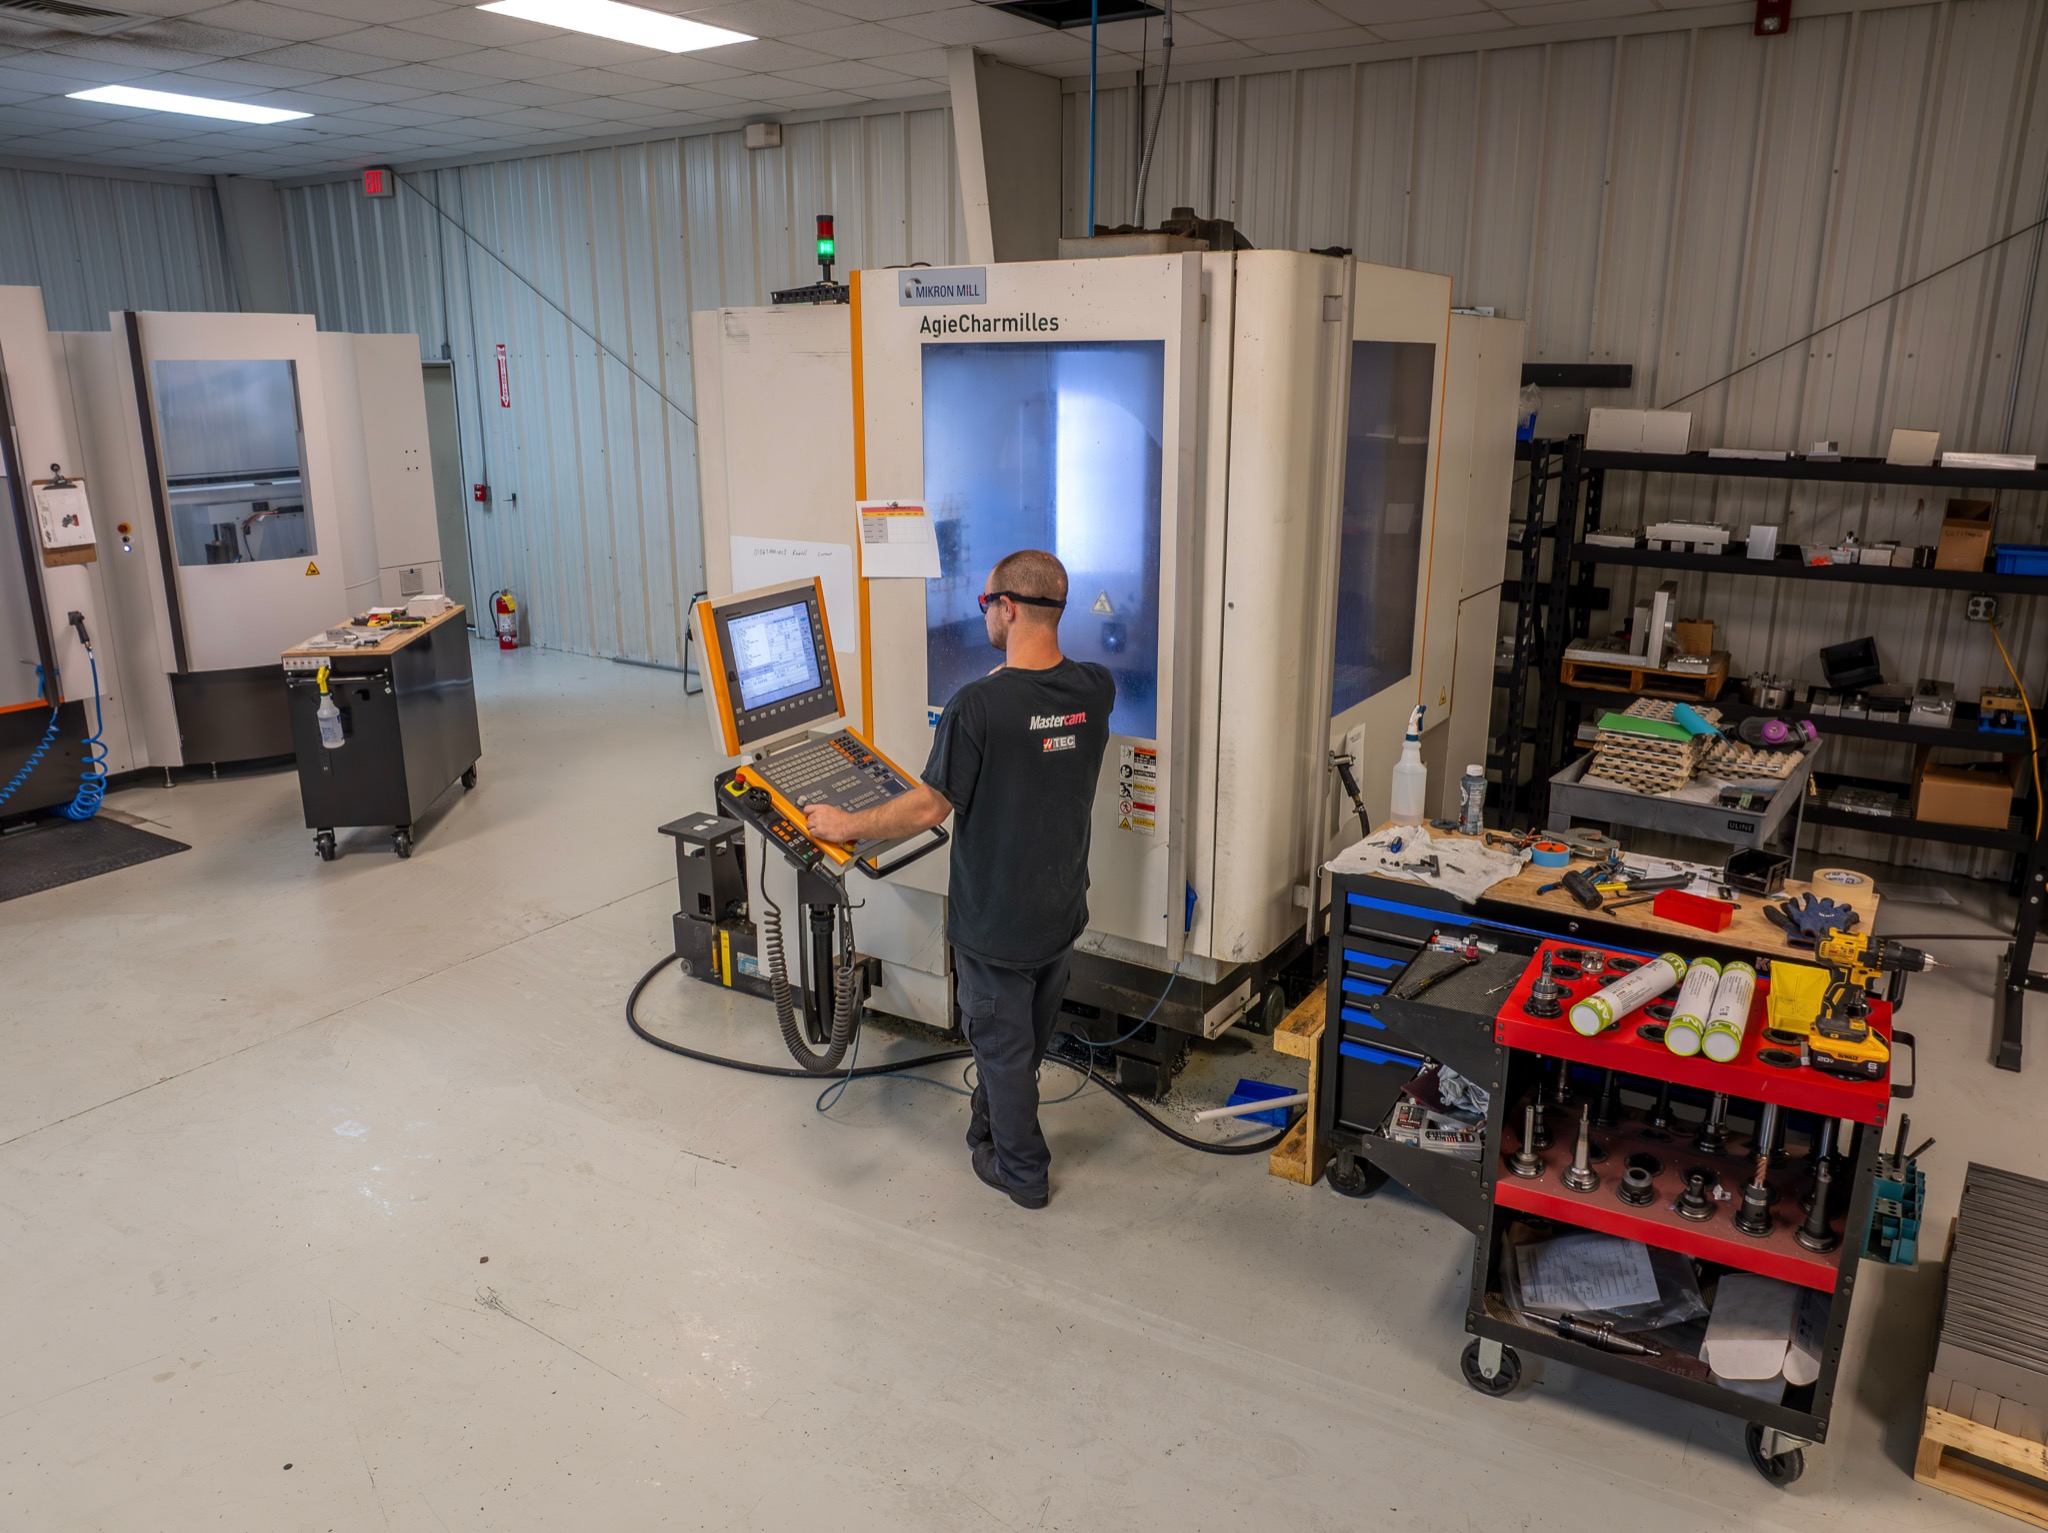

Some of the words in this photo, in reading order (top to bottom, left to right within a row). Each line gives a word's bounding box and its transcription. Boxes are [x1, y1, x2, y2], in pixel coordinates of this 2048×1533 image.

[365, 170, 383, 194] EXIT
[915, 285, 954, 298] MIKRON
[956, 284, 980, 297] MILL
[919, 312, 1060, 338] AgieCharmilles
[1029, 711, 1086, 731] Mastercam
[1053, 736, 1074, 748] TEC
